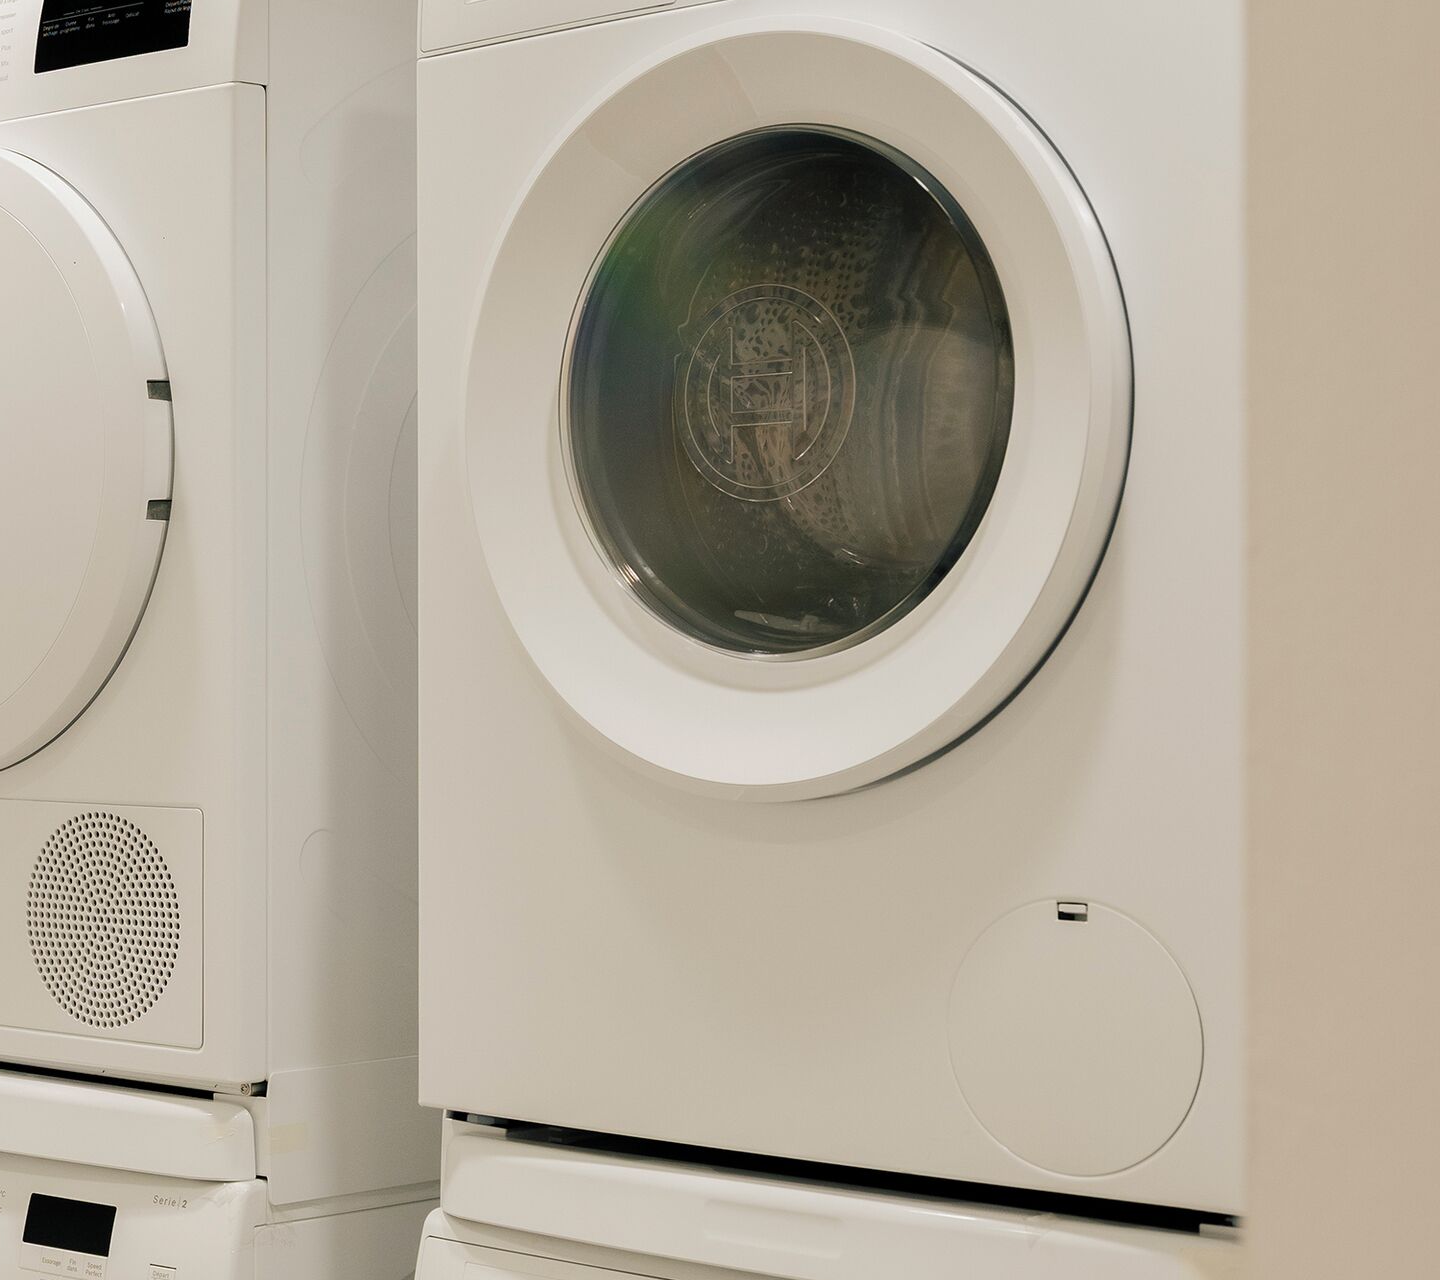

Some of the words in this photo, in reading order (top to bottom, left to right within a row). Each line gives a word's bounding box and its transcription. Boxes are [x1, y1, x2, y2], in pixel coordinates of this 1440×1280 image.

[152, 1194, 177, 1207] Serie
[181, 1199, 188, 1209] 2
[88, 1262, 102, 1270] Speed
[85, 1269, 102, 1278] Perfect
[152, 1270, 169, 1279] Départ
